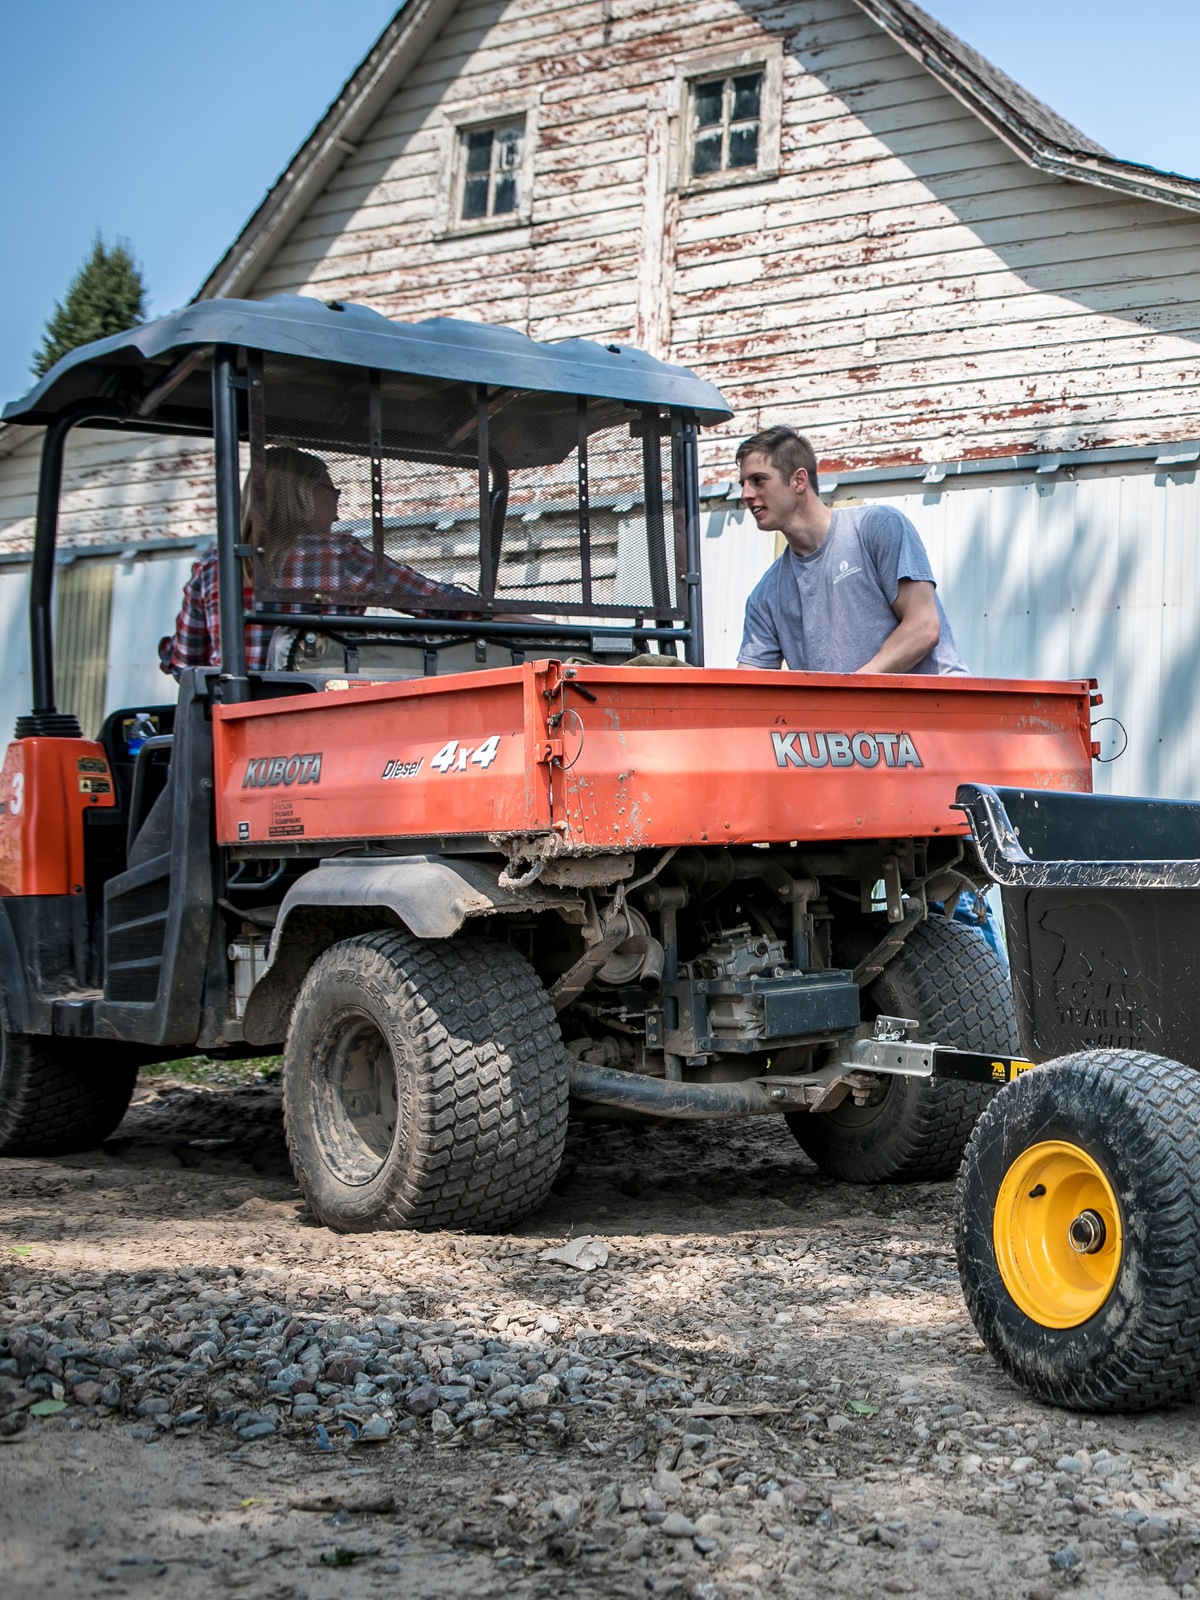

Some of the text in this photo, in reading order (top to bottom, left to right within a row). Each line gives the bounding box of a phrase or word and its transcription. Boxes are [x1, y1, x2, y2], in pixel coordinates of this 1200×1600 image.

[382, 735, 500, 780] Diesel 4x4
[770, 731, 925, 768] KUBOTA
[242, 752, 323, 788] KUBOTA
[1052, 979, 1146, 1008] POLAR
[1056, 1006, 1143, 1032] TRAILER
